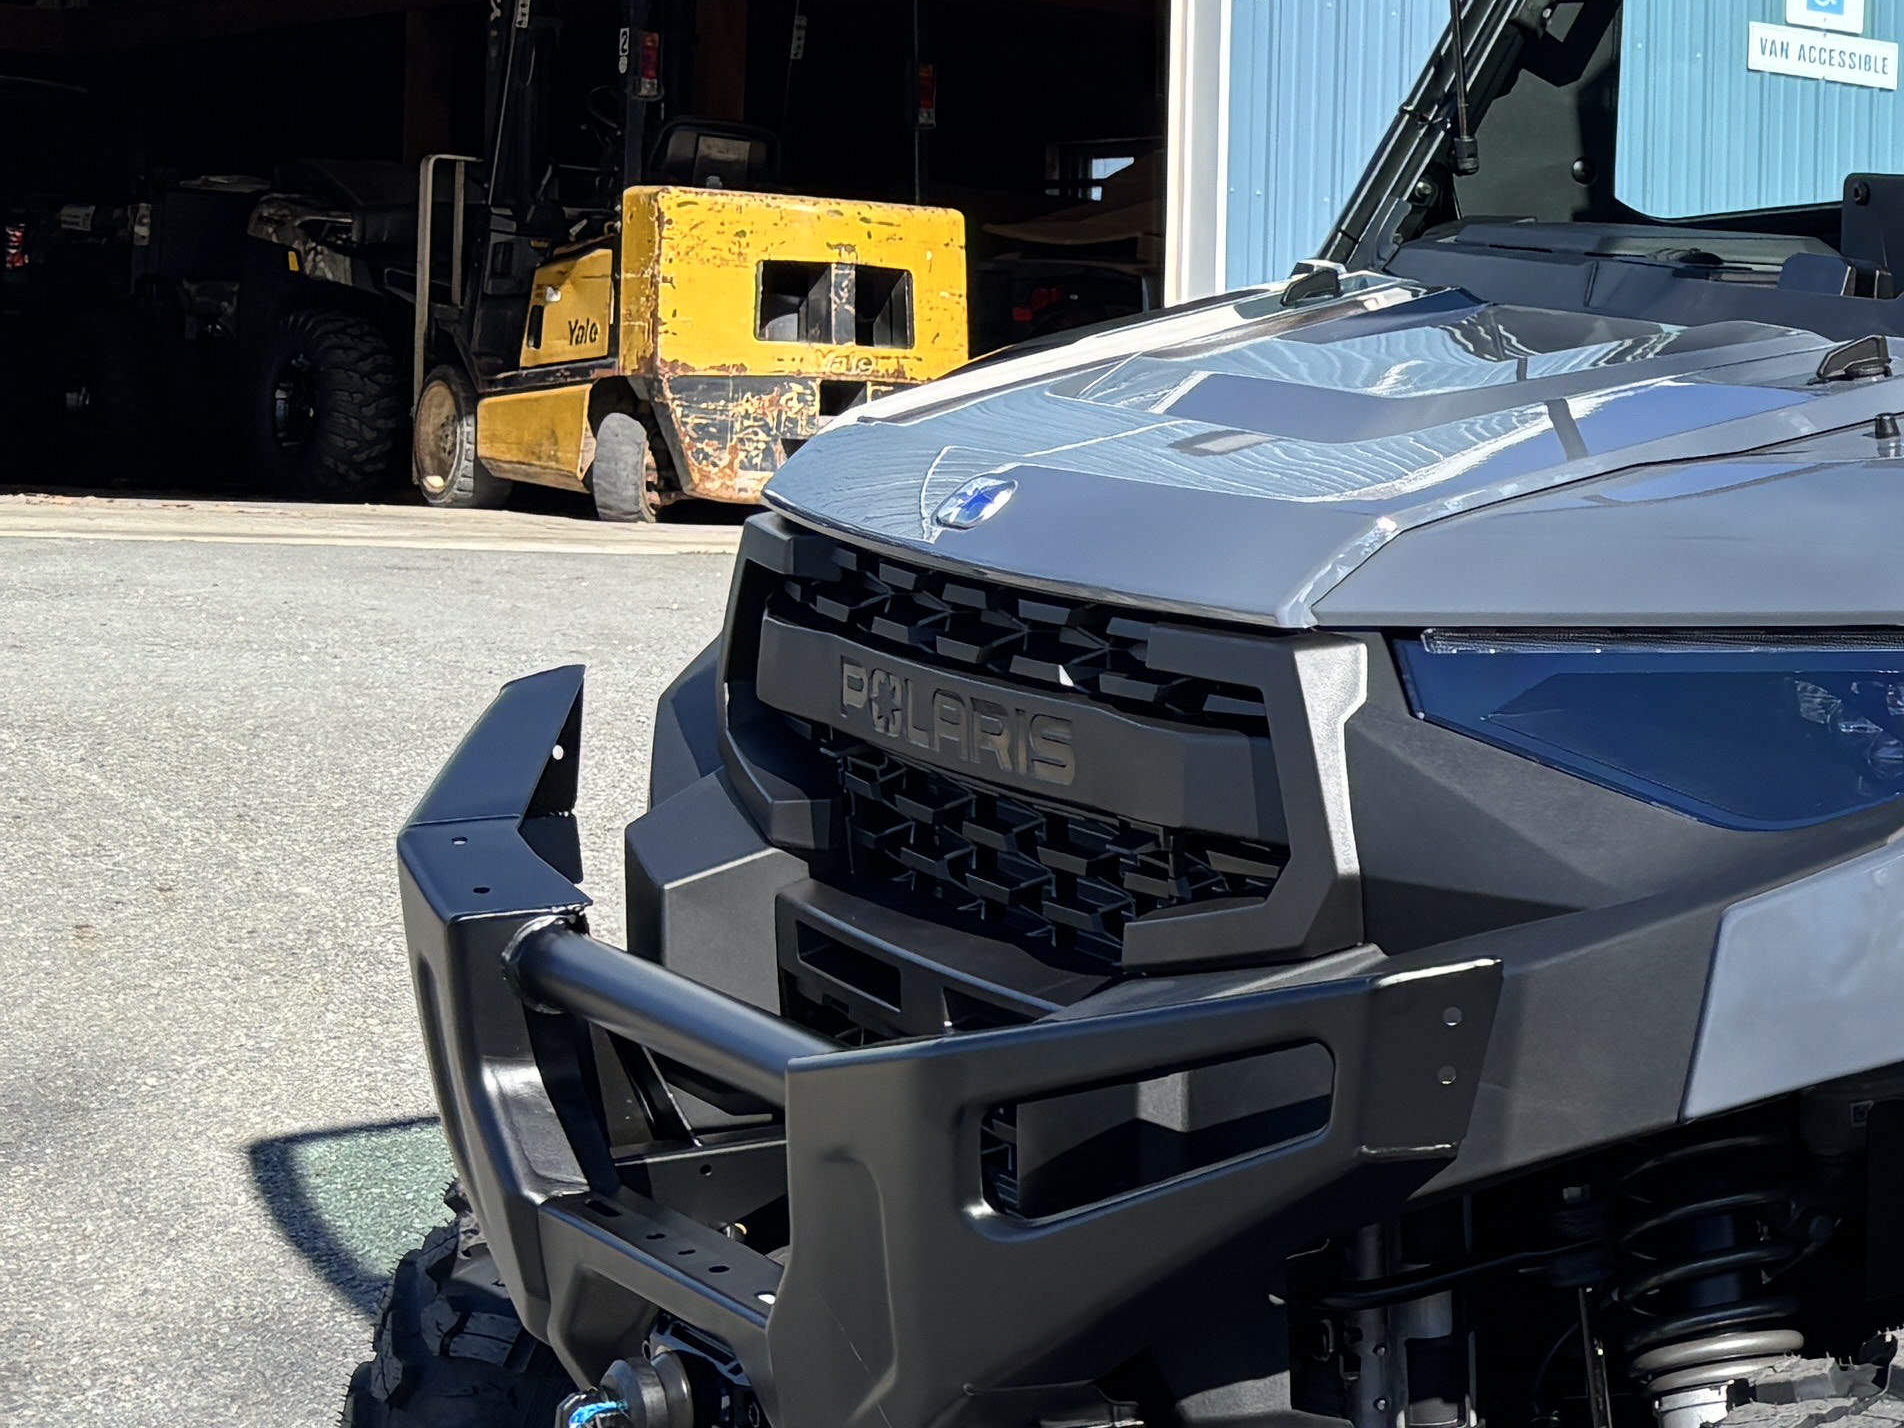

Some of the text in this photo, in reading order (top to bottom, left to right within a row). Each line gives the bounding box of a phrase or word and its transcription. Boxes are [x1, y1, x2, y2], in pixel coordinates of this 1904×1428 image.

[1759, 37, 1889, 75] VAN ACCESSIBLE
[568, 317, 599, 346] Yale
[815, 348, 876, 375] Yale
[840, 654, 1077, 786] POLARIS
